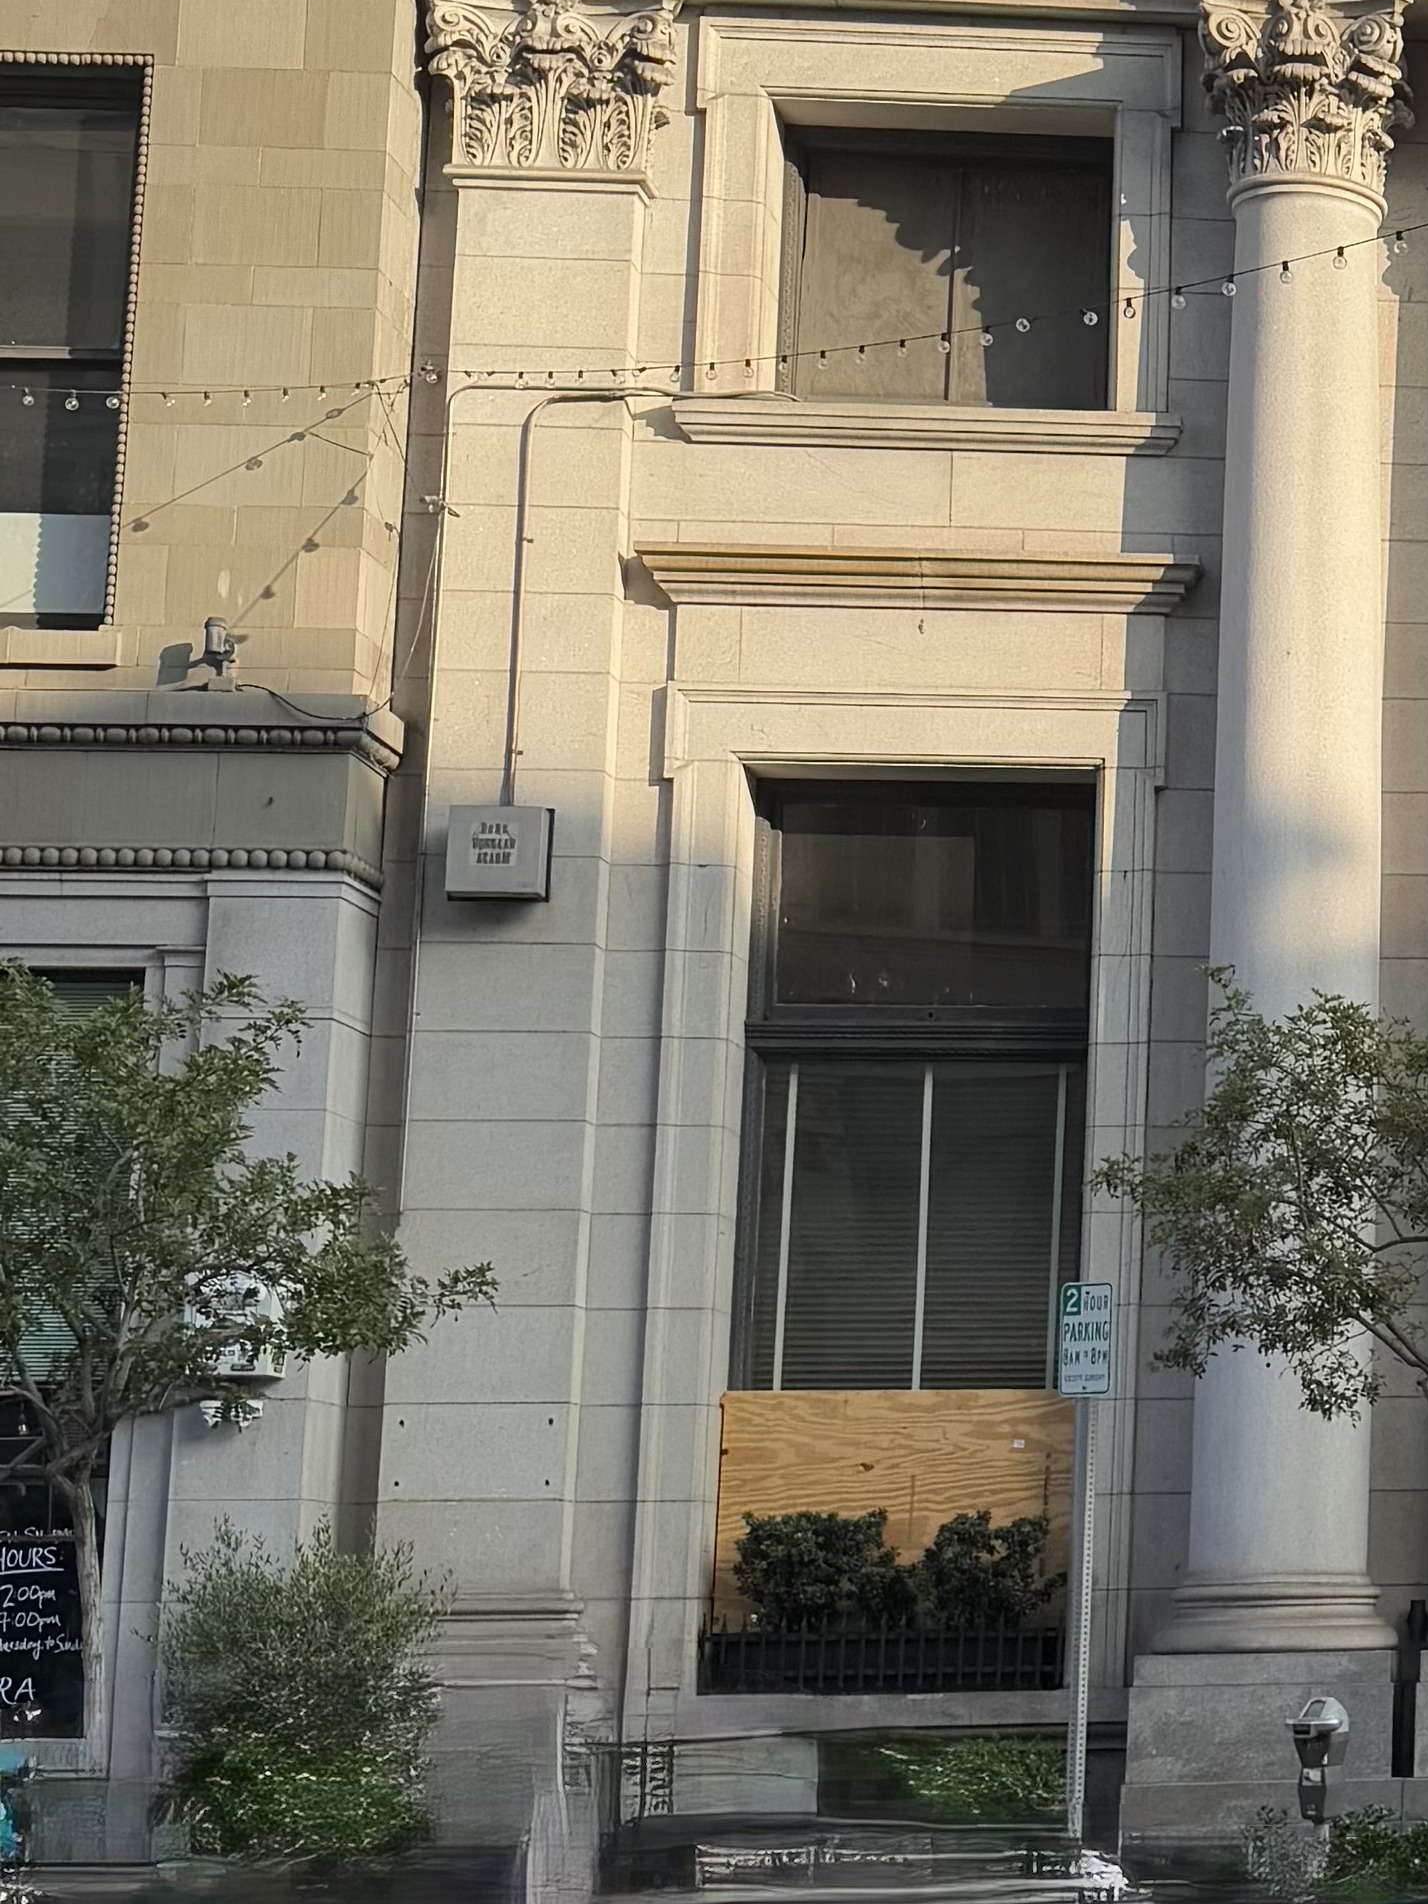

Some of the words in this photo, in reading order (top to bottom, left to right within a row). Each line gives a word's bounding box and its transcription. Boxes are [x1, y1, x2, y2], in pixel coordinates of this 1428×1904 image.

[1065, 1288, 1079, 1313] 2
[1083, 1294, 1109, 1311] HOUR
[1063, 1320, 1109, 1343] PARKING
